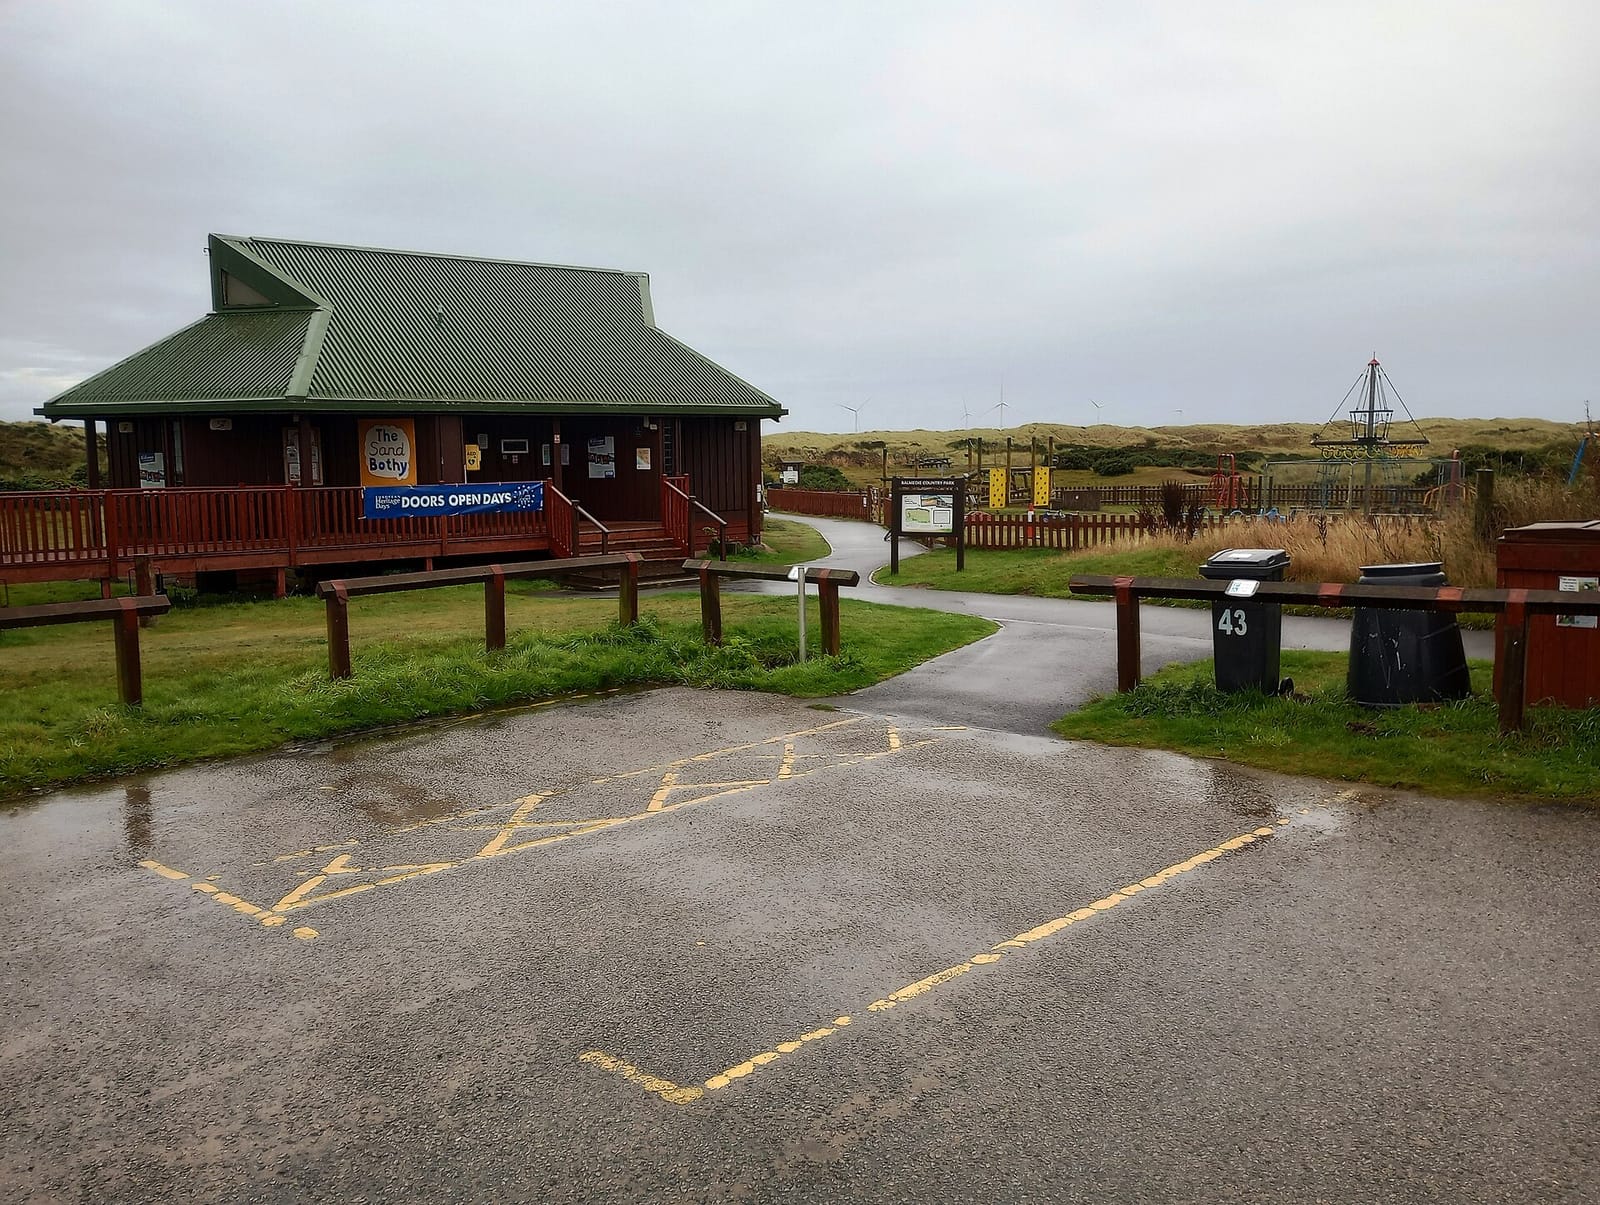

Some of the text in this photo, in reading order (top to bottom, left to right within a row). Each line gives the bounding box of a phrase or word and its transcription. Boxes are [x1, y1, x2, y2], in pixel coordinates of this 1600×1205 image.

[375, 428, 398, 442] The
[369, 441, 405, 456] Sand
[369, 457, 407, 476] Bothy
[401, 492, 512, 508] DOORS OPEN DAYS
[1218, 608, 1247, 635] 43
